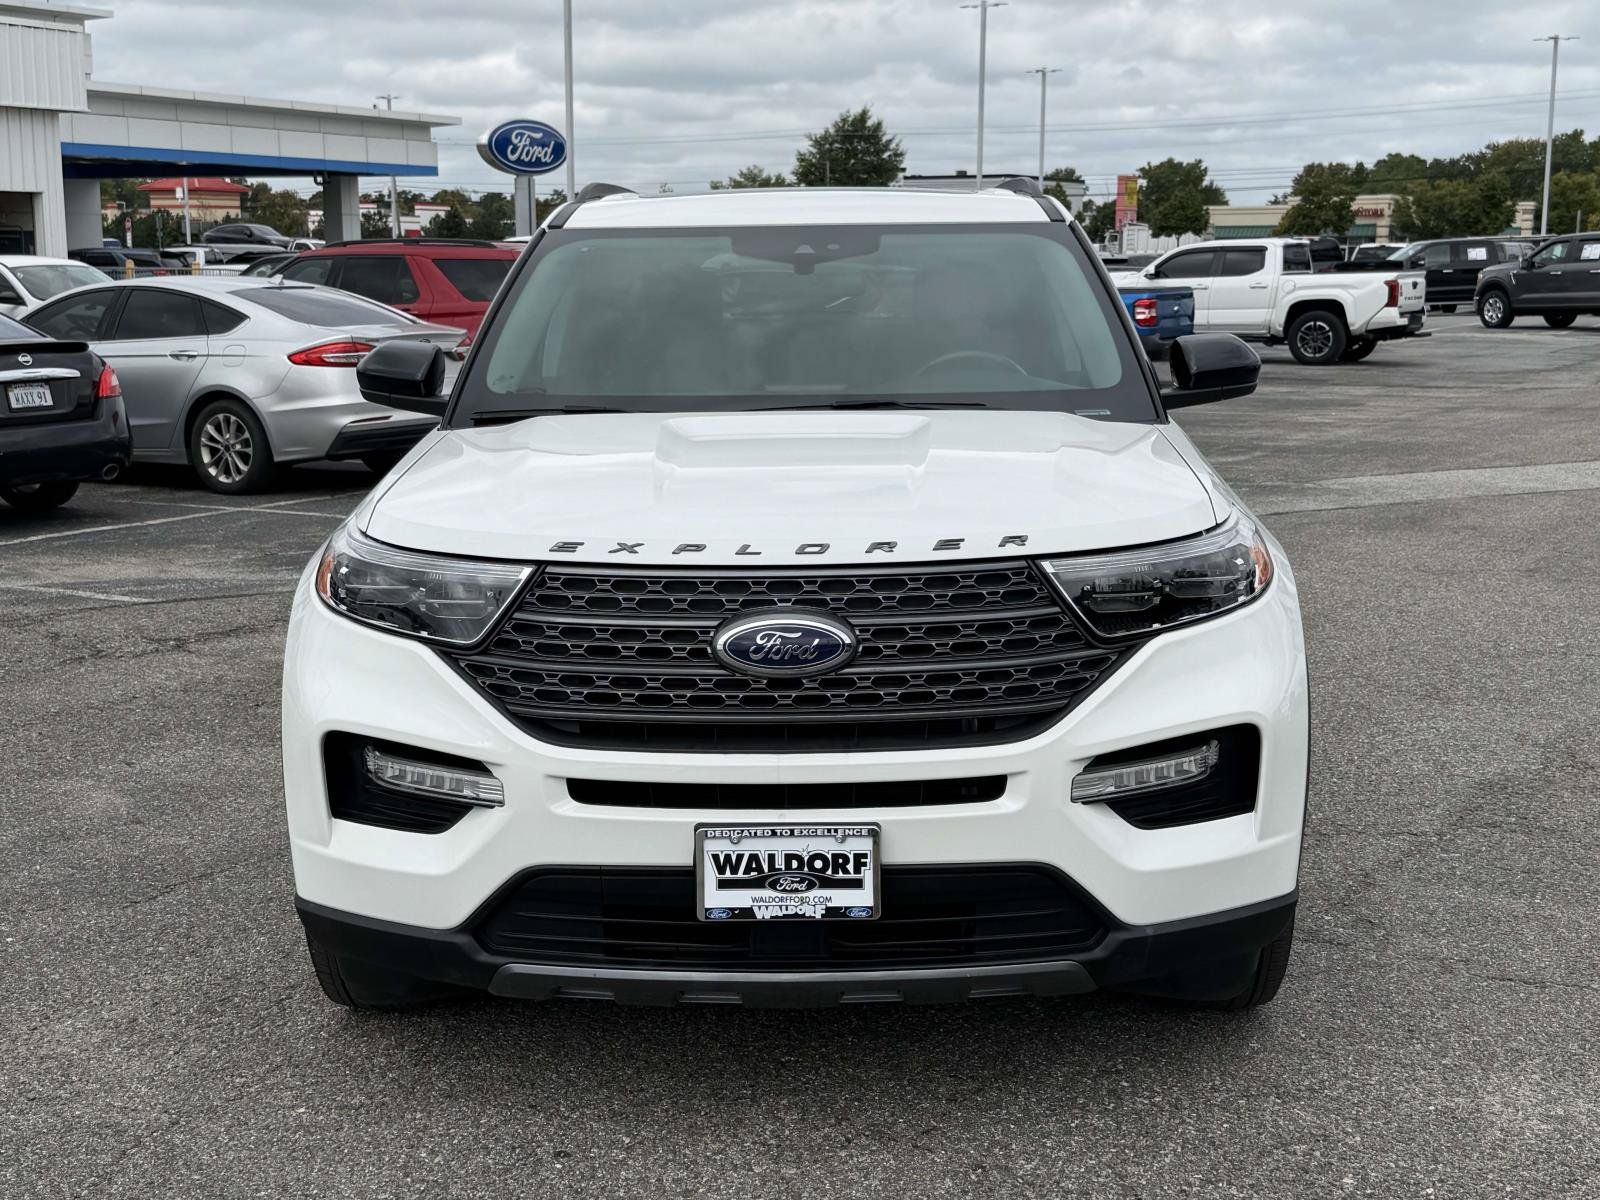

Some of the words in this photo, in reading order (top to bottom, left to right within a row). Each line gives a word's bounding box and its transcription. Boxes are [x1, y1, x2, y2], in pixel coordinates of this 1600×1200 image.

[507, 129, 555, 163] Ford
[548, 534, 1029, 555] EXPLORER
[748, 630, 820, 661] Ford
[707, 829, 772, 838] DEDICATED
[774, 828, 791, 836] TO
[793, 827, 870, 837] EXCELLENCE
[709, 850, 870, 877] WALDORF
[775, 877, 809, 891] Ford
[751, 895, 832, 904] WALDORFFORD.COM
[710, 908, 730, 918] Ford
[850, 907, 870, 917] Ford
